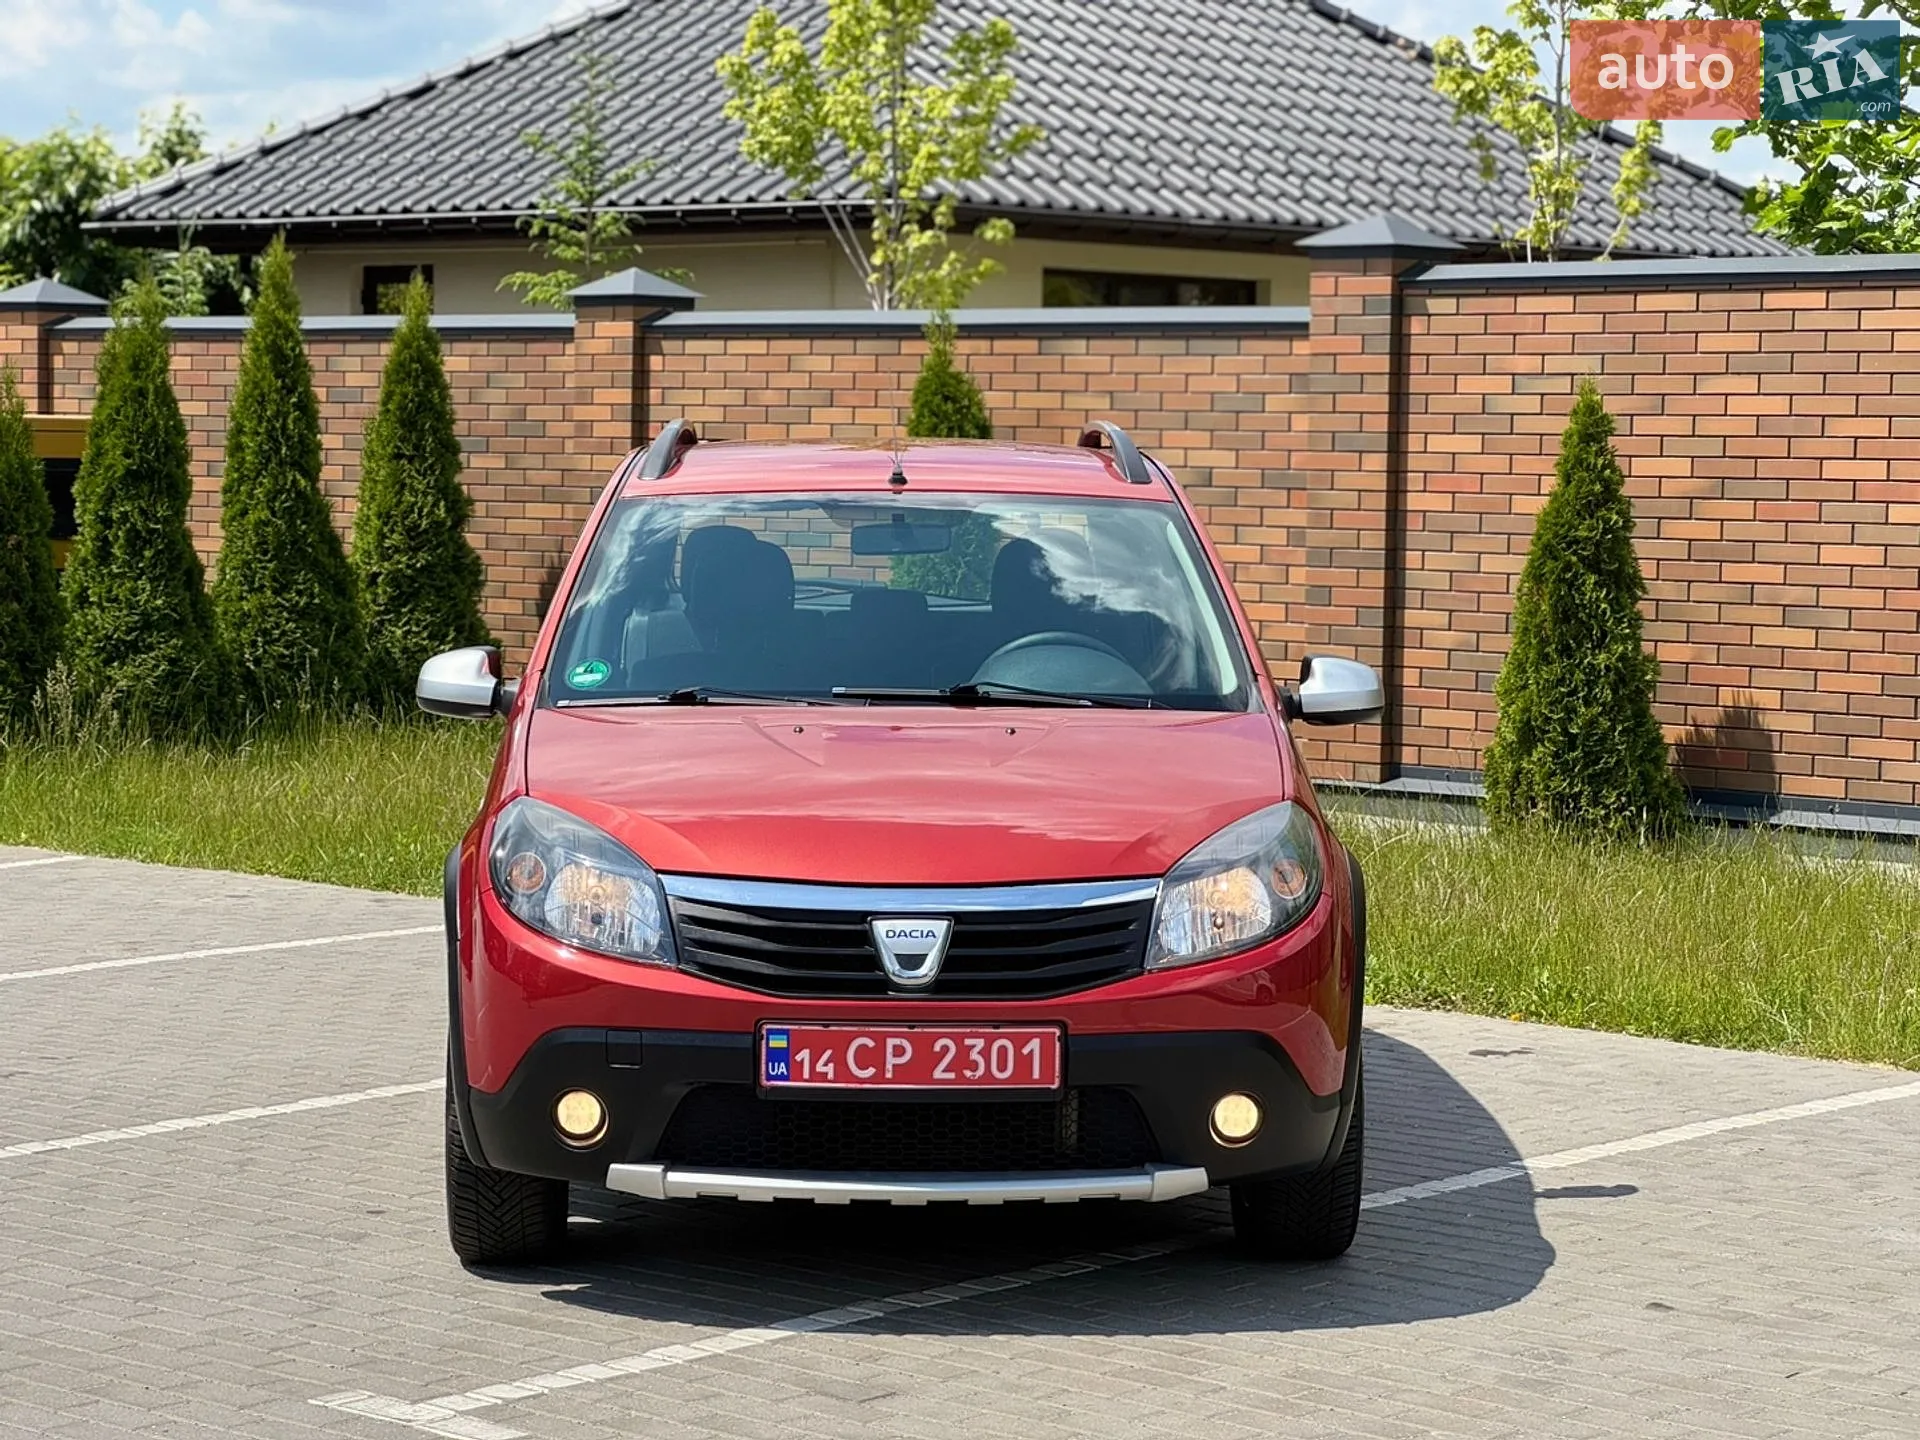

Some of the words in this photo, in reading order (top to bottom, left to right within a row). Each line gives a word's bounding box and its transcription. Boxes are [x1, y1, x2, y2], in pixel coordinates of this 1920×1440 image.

[885, 929, 937, 939] DACIA
[794, 1048, 835, 1081] 14
[846, 1037, 912, 1079] CP
[932, 1037, 1042, 1081] 2301
[768, 1062, 788, 1076] UA
